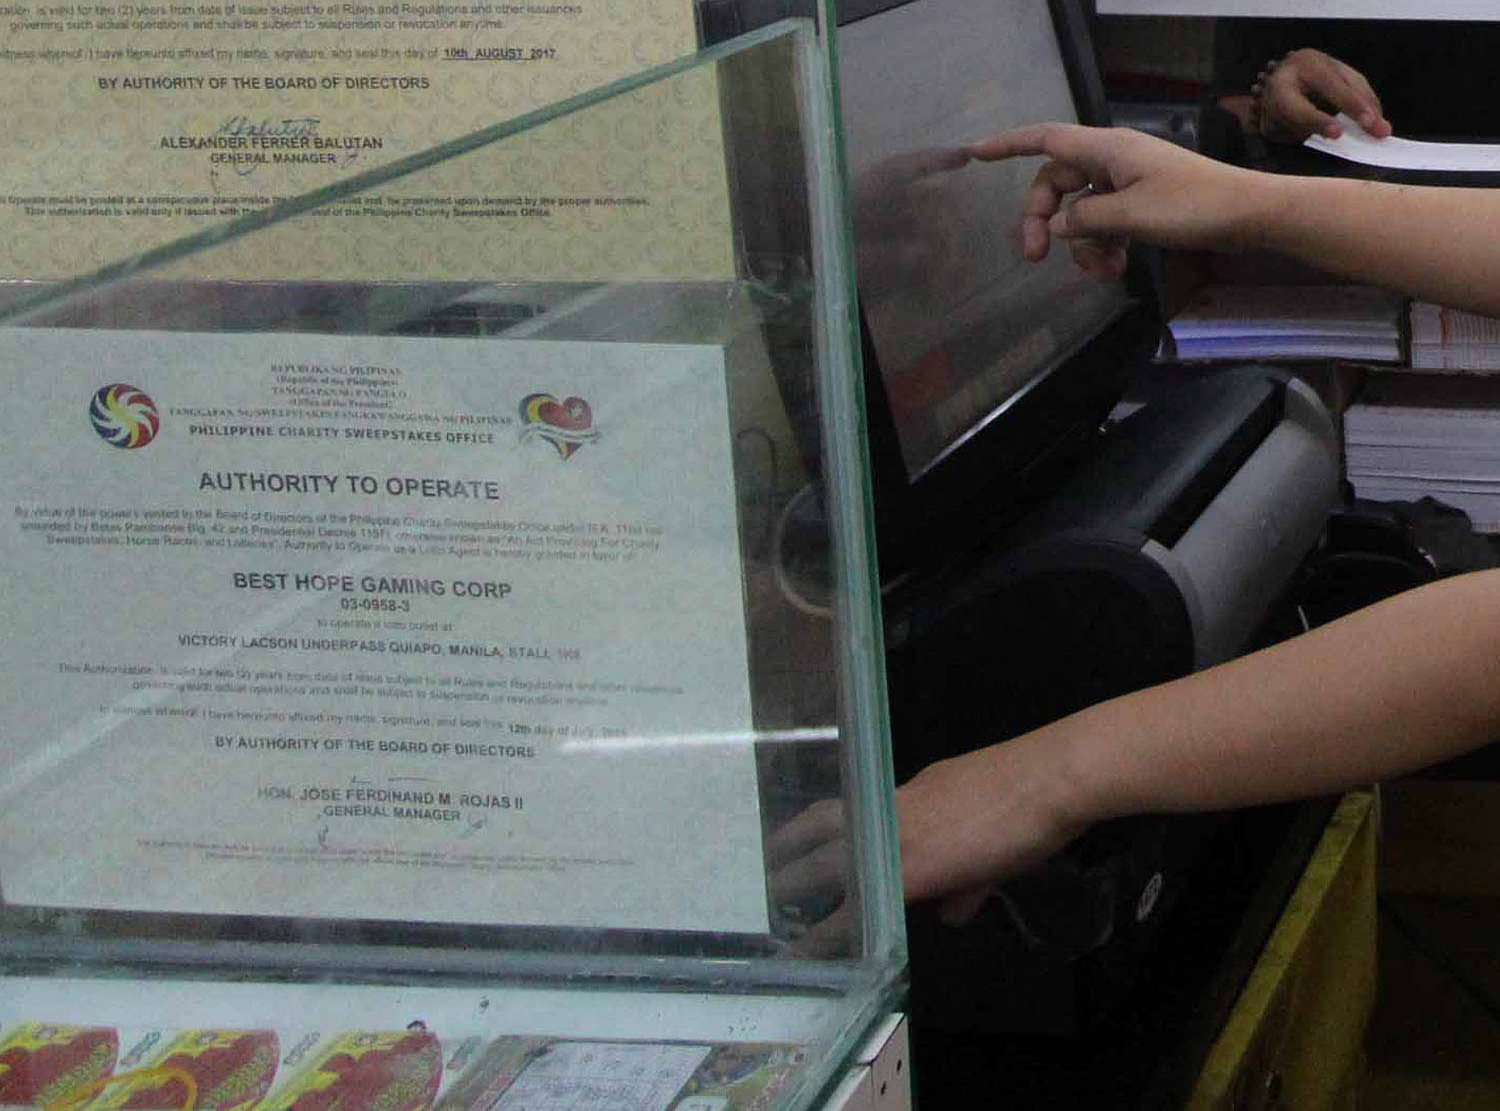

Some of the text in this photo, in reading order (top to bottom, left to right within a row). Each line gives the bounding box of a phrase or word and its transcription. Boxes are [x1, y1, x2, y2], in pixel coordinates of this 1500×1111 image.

[476, 47, 524, 59] AUGUST
[530, 47, 557, 59] 2017
[99, 77, 430, 90] BY AUTHORITY OF THE BOARD OF DIRECTORS
[160, 136, 383, 149] ALEXANDER FERRER BALUTAN
[210, 153, 337, 164] GENERAL MANAGER
[189, 425, 496, 444] PHILIPPINE CHARITY SWEEPSTAKES OFFICE
[200, 472, 500, 501] AUTHORITY TO OPERATE
[233, 572, 512, 599] BEST HOPE GAMING CORP
[340, 597, 410, 613] 03-0958-3
[178, 634, 237, 647] VICTORY
[241, 636, 298, 649] LACSON
[301, 639, 386, 653] UNDERPASS
[215, 736, 535, 759] BY AUTHORITY OF THE BOARD OF DIRECTORS
[300, 788, 341, 802] JOSE
[346, 789, 435, 805] FERDINAND
[460, 794, 511, 809] ROJAS
[323, 804, 461, 822] GENERAL MANAGER
